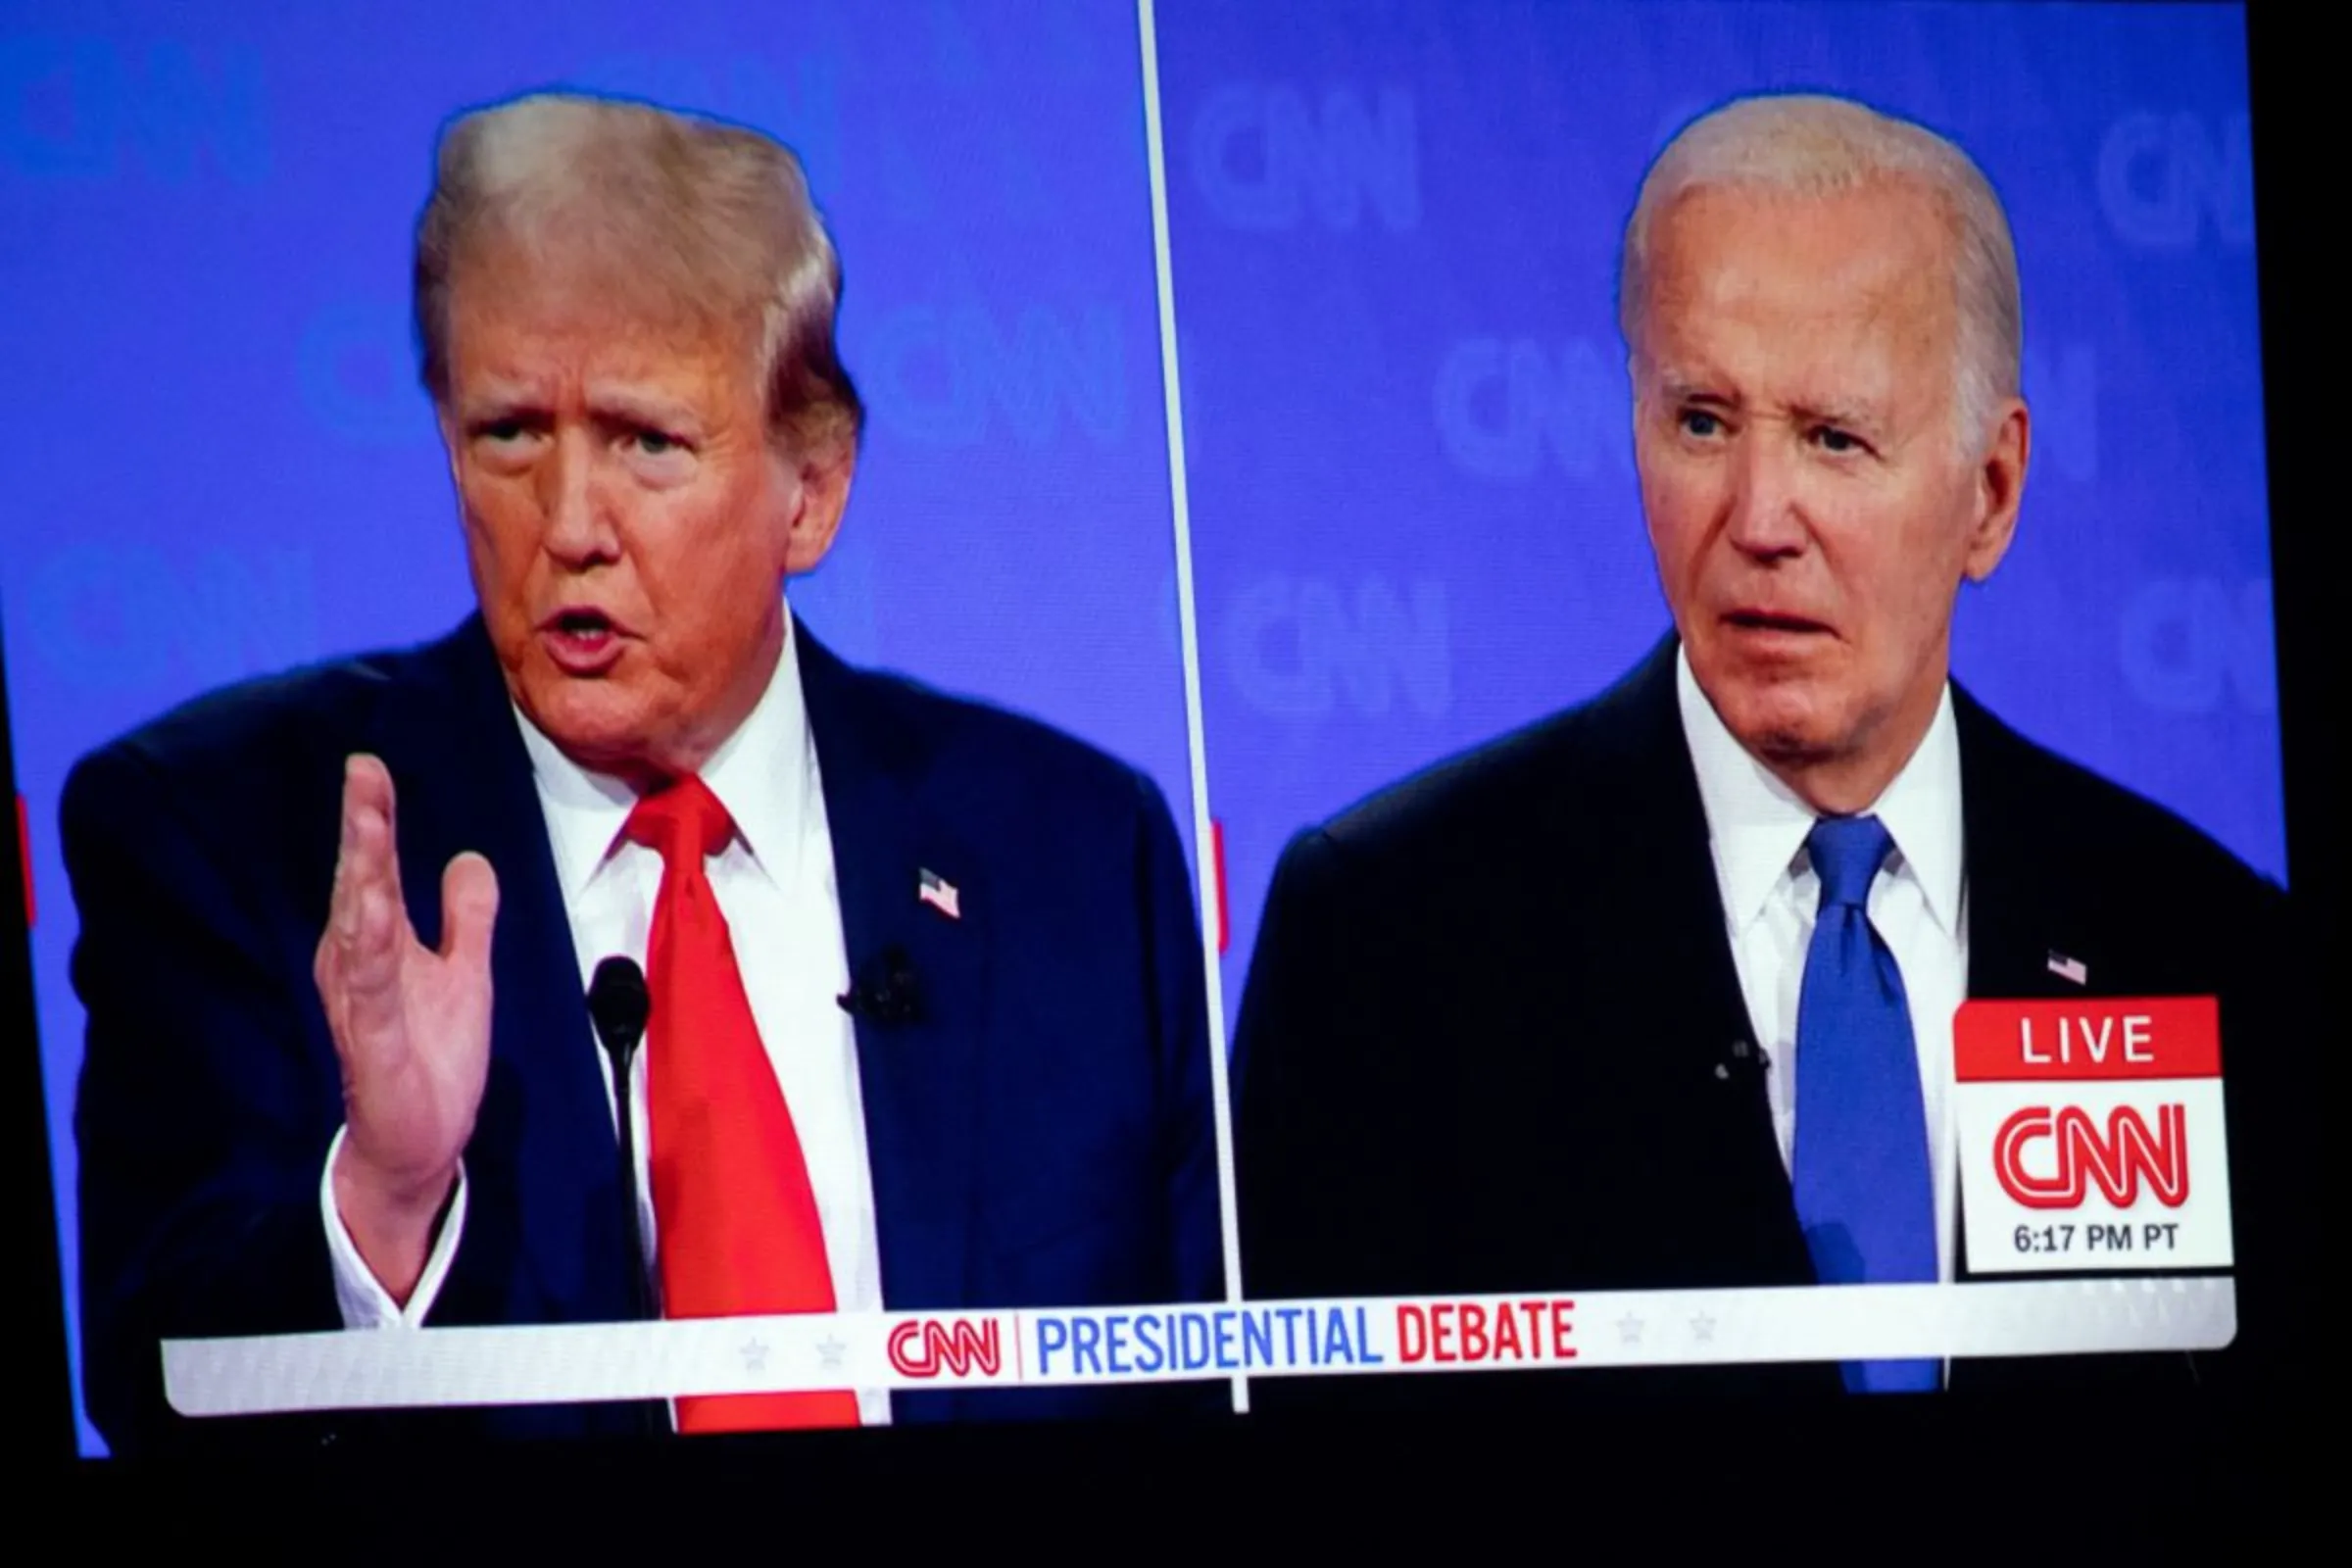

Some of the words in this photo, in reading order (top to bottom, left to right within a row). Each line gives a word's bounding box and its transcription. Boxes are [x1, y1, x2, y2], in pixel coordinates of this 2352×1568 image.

[1192, 82, 1421, 231] CNN
[866, 302, 1124, 447] CNN
[1226, 572, 1452, 717] CNN
[2021, 1015, 2154, 1063] LIVE
[1993, 1102, 2189, 1210] CNN
[2014, 1224, 2076, 1252] 6:17
[2086, 1225, 2132, 1251] PM
[2143, 1223, 2179, 1250] PT
[887, 1318, 1001, 1378] CNN
[1037, 1305, 1383, 1376] PRESIDENTIAL
[1396, 1300, 1578, 1364] DEBATE
